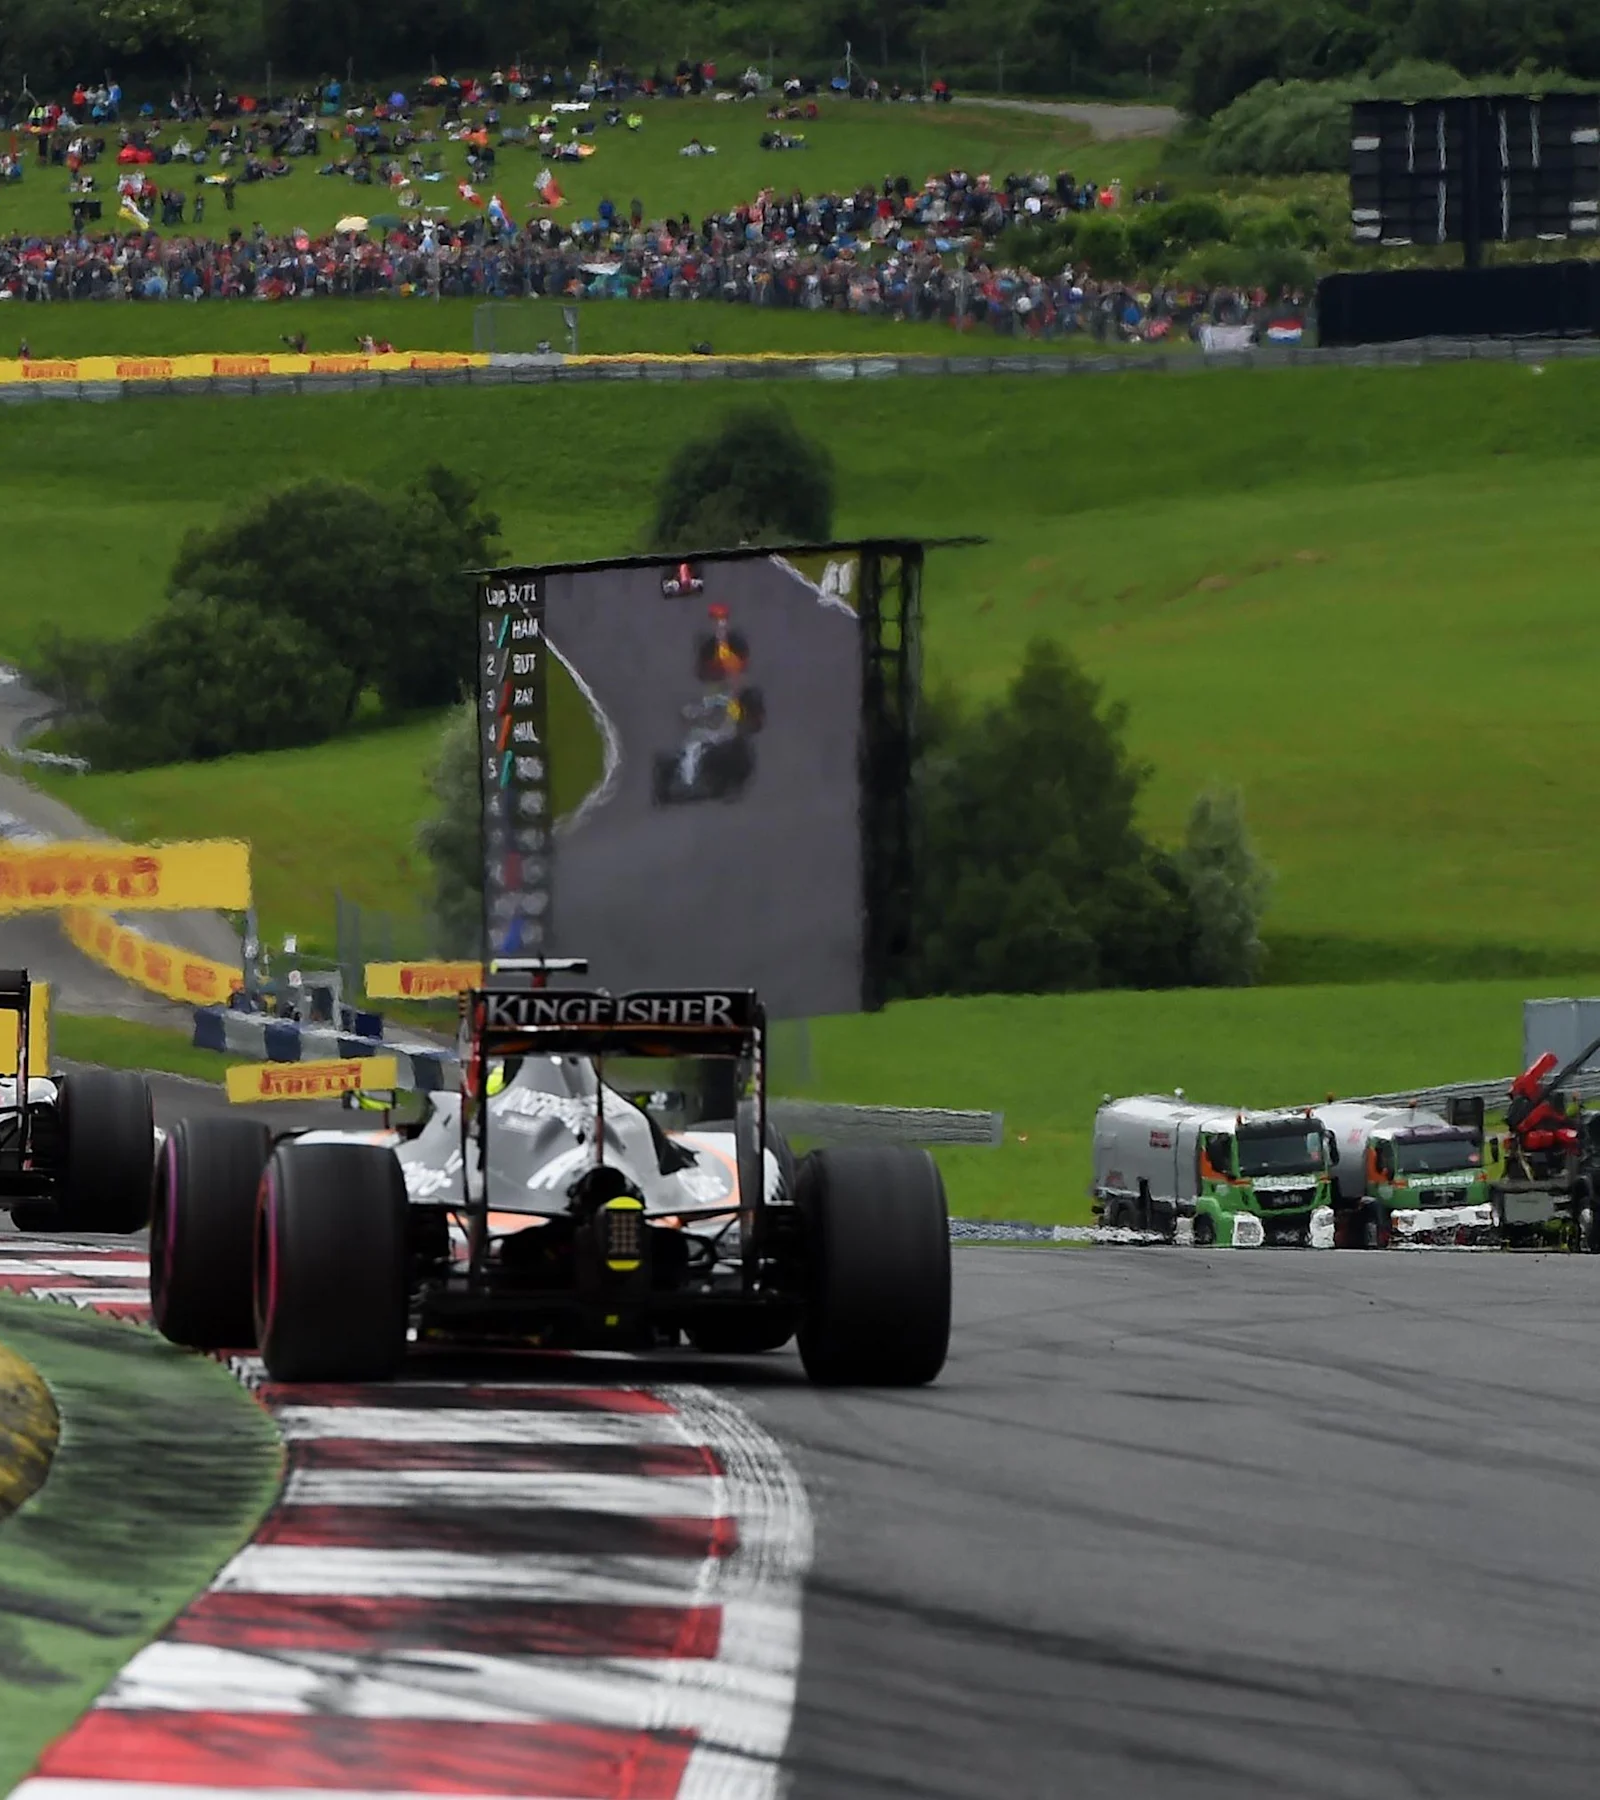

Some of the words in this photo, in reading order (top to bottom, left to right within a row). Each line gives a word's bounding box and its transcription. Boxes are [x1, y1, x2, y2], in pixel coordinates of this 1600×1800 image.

[486, 587, 507, 608] Lap
[512, 618, 539, 640] HAM
[486, 653, 496, 677] 2
[486, 688, 497, 712] 3
[487, 995, 736, 1026] KINGFISHER
[260, 1064, 362, 1095] PIRELLI
